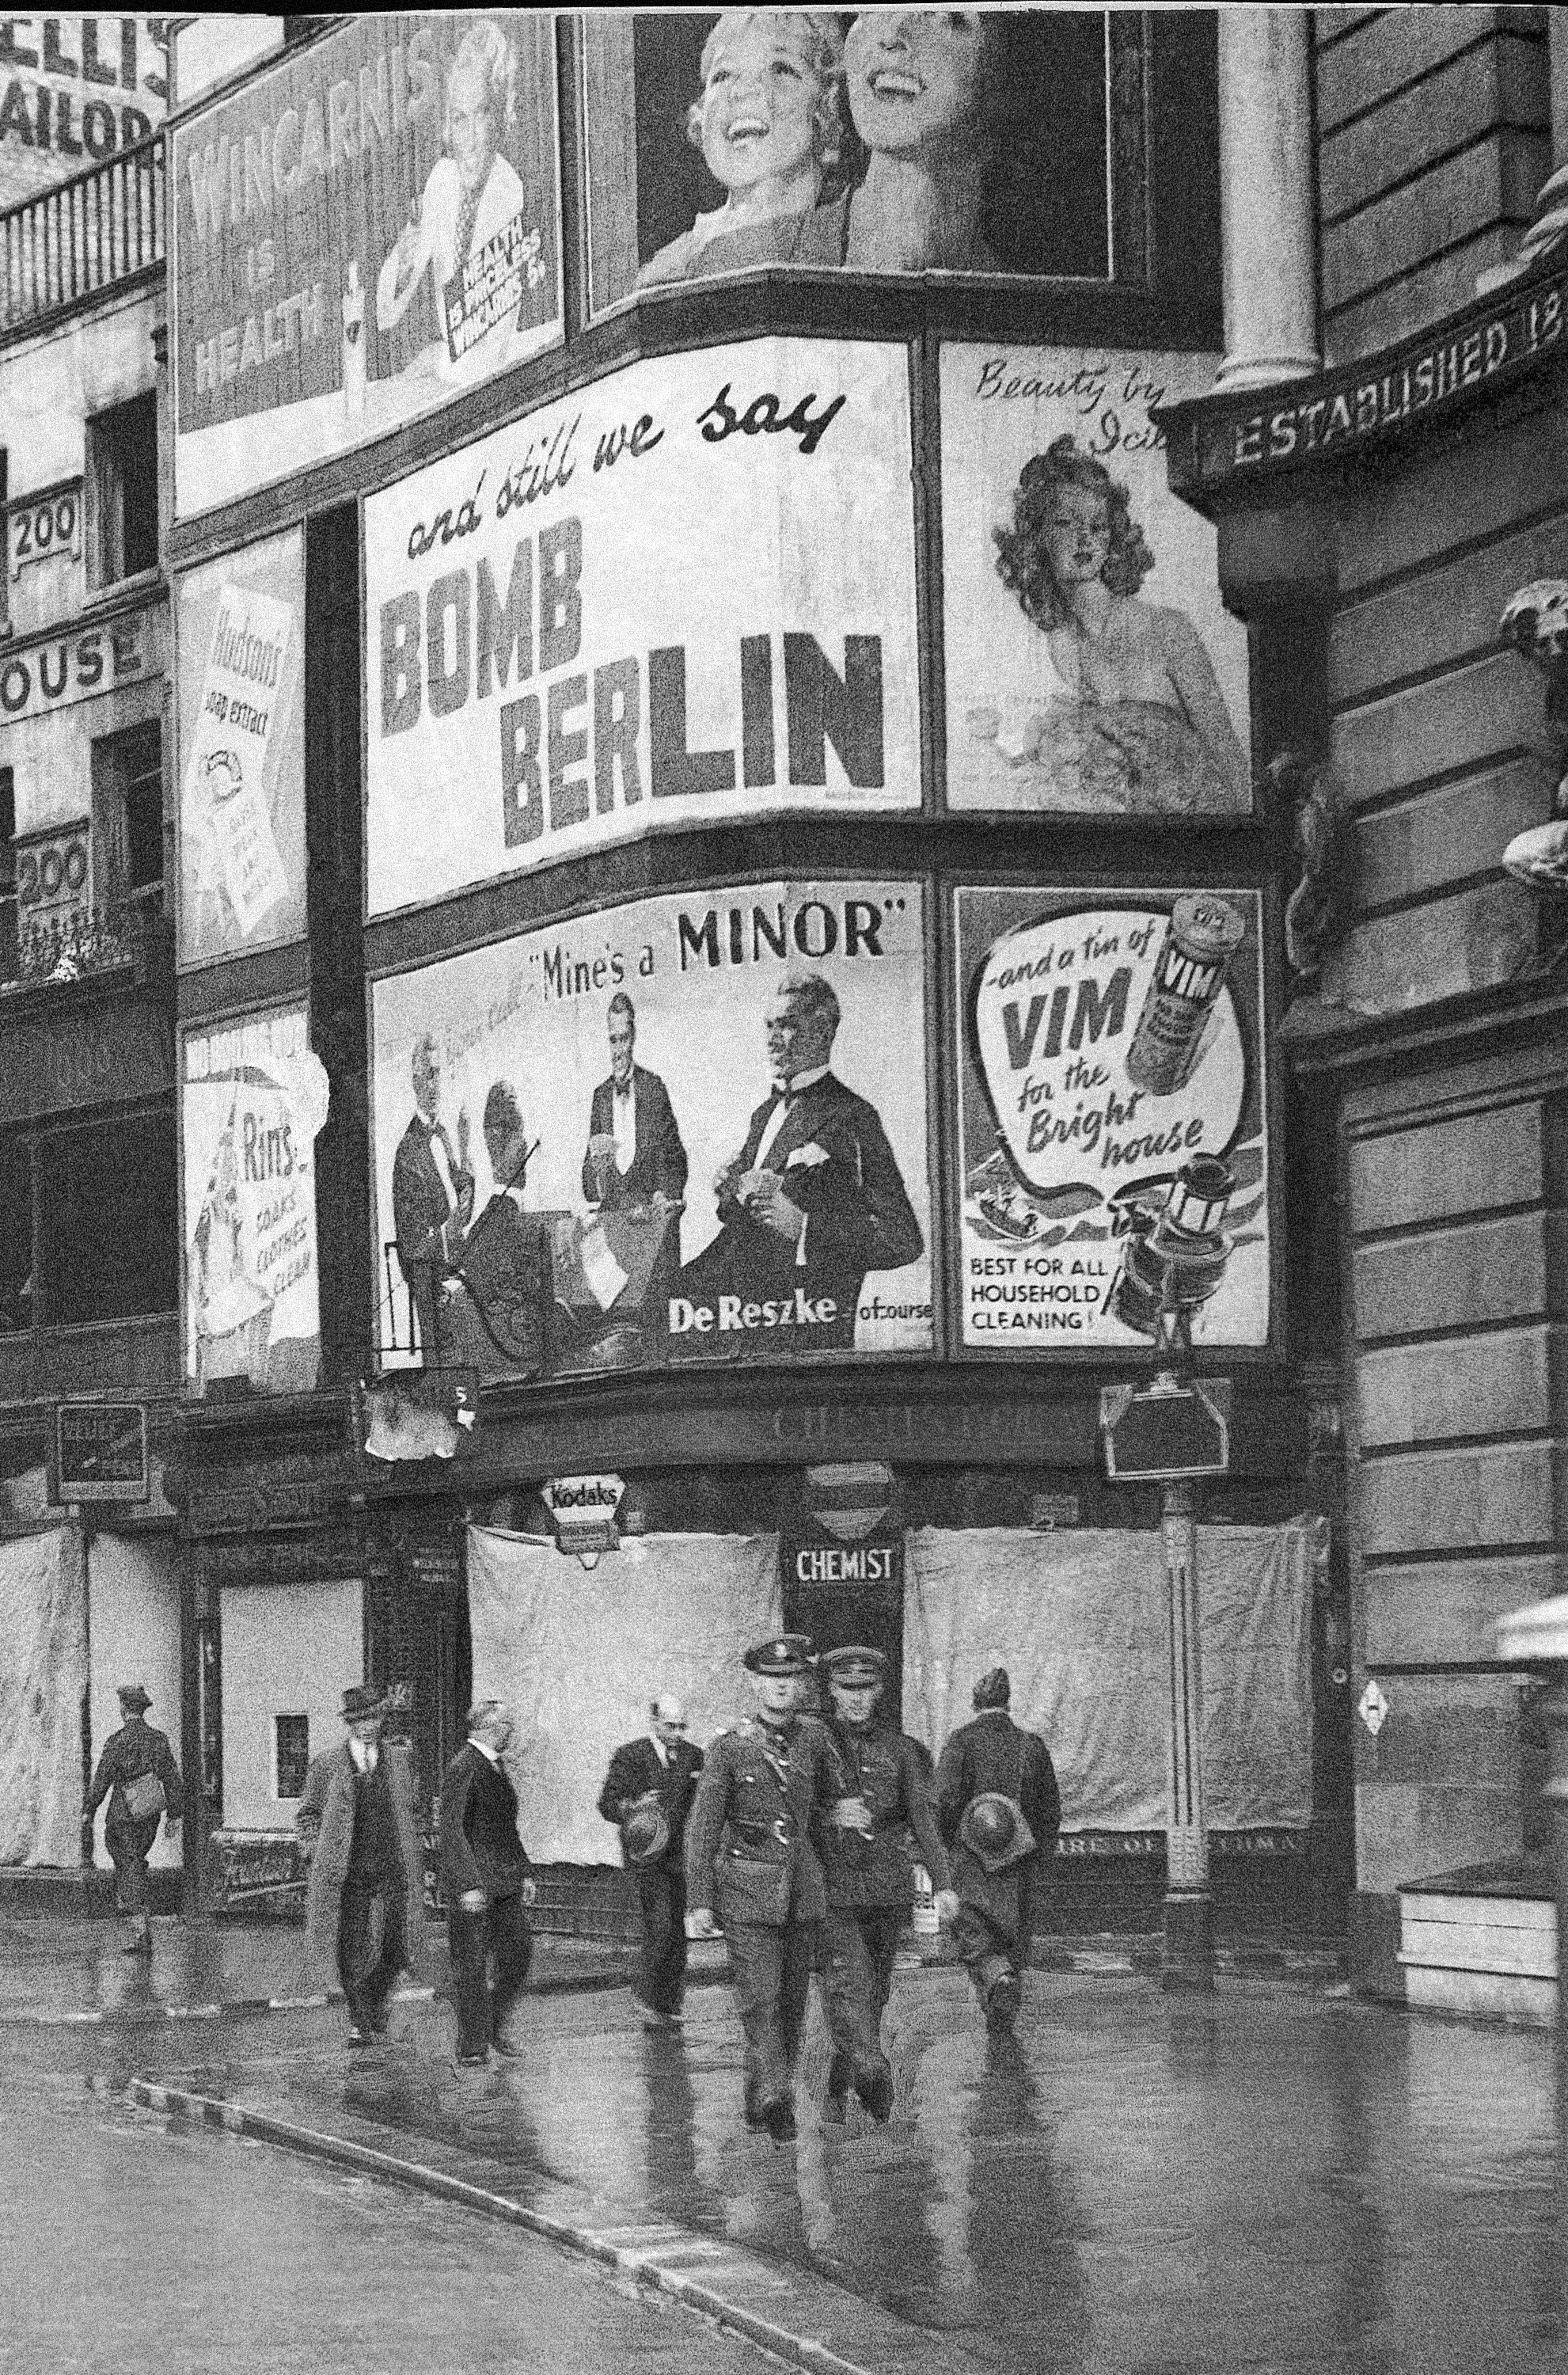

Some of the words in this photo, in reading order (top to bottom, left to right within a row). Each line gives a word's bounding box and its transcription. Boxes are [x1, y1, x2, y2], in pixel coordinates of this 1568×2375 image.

[188, 28, 437, 241] WINCARNIS
[247, 238, 275, 291] IS
[463, 215, 523, 292] HEALTH
[196, 283, 324, 395] HEALTH
[975, 359, 1108, 414] Beauty
[1122, 367, 1167, 411] by
[1233, 322, 1508, 466] ESTABLISHED
[408, 469, 487, 560] and
[495, 413, 583, 519] still
[593, 413, 665, 474] we
[696, 382, 848, 455] say
[14, 497, 75, 557] 200
[379, 515, 583, 739] BOMB
[0, 618, 142, 712] OUSE
[499, 631, 885, 849] BERLIN
[19, 841, 88, 905] 200
[639, 944, 655, 977] a
[1058, 950, 1075, 971] a
[1083, 925, 1119, 960] tin
[1128, 918, 1156, 959] of
[1164, 949, 1217, 998] VIM
[1001, 967, 1133, 1071] VIM
[1017, 1074, 1054, 1113] for
[1065, 1055, 1111, 1092] the
[1026, 1091, 1146, 1153] Bright
[1100, 1118, 1205, 1169] house
[970, 1257, 1017, 1276] BEST
[1024, 1258, 1064, 1276] FOR
[1070, 1260, 1110, 1276] ALL
[970, 1284, 1100, 1303] HOUSEHOLD
[669, 1298, 715, 1333] De
[718, 1288, 837, 1331] Reszke
[454, 1386, 468, 1404] 5
[550, 1481, 617, 1509] Kodaks
[795, 1547, 894, 1582] CHEMIST
